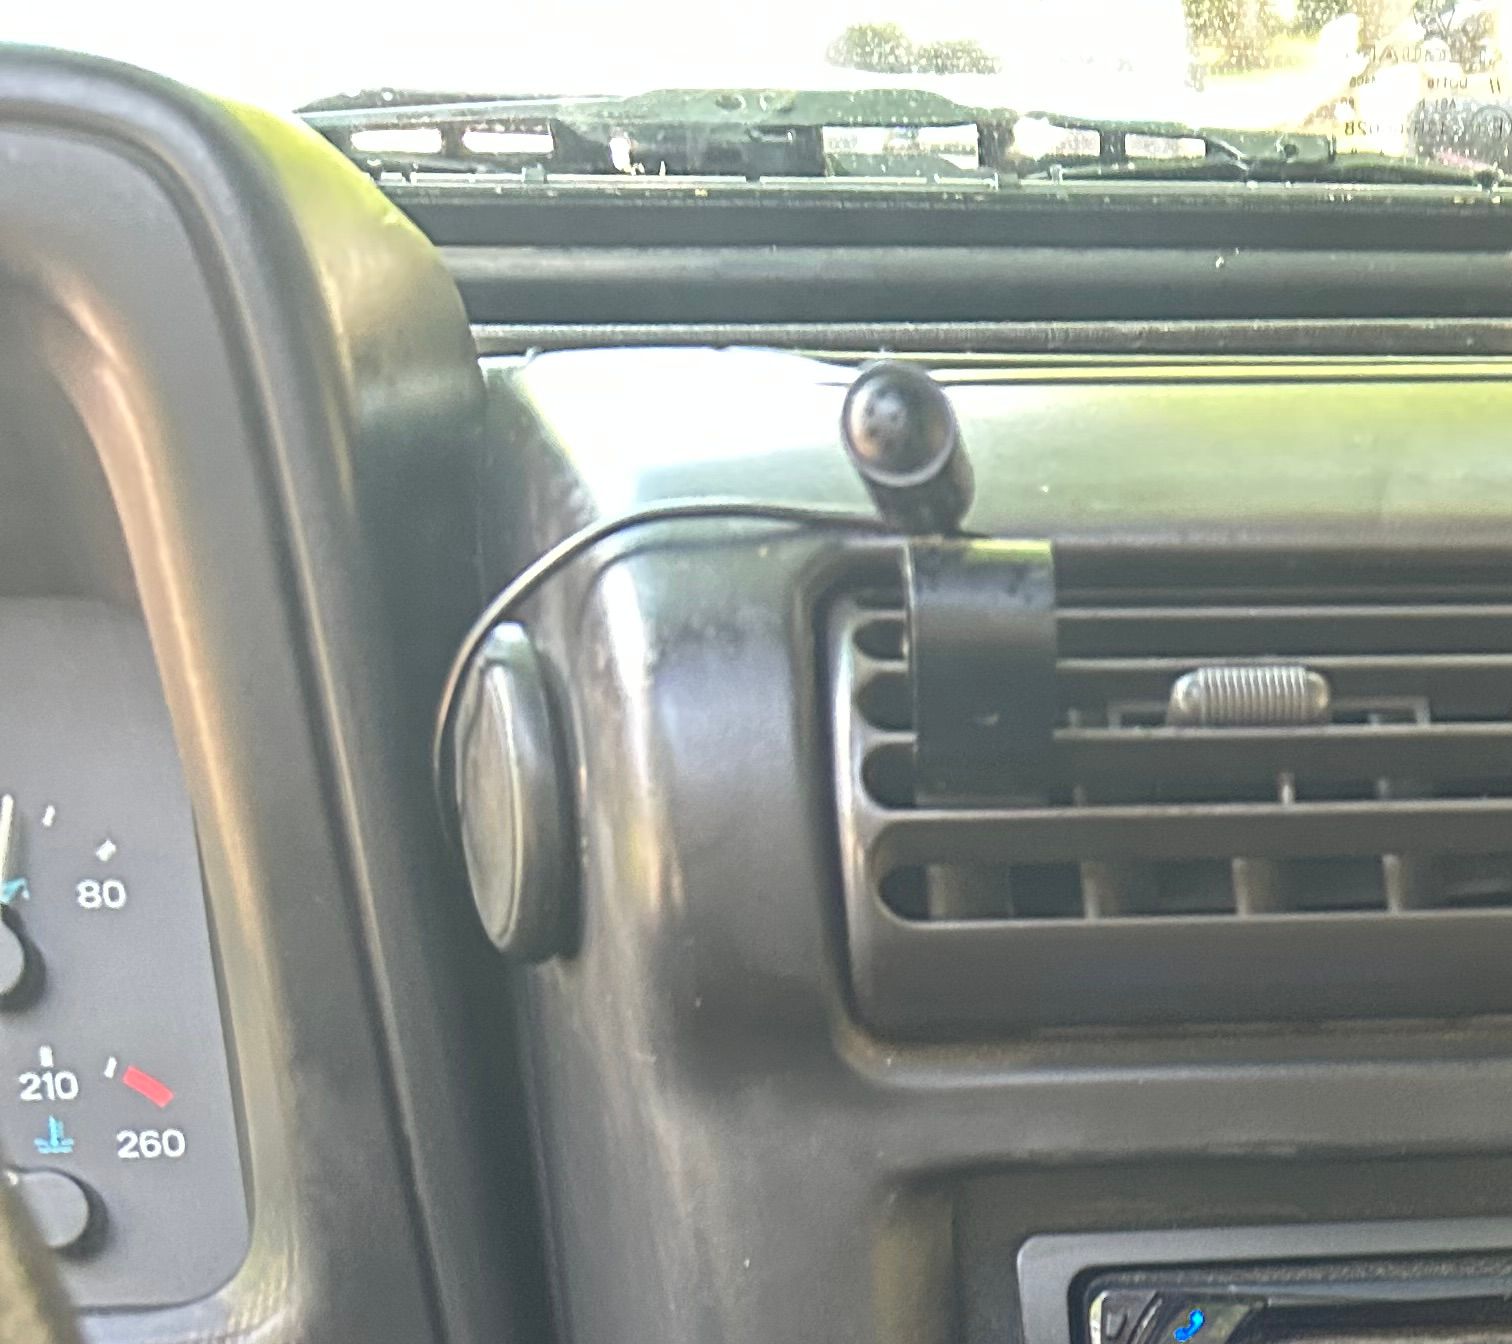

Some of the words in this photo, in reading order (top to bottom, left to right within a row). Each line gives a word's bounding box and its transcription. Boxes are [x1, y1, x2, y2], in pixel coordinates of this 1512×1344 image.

[76, 879, 127, 909] 80
[19, 1072, 79, 1101] 210
[116, 1128, 186, 1159] 260
